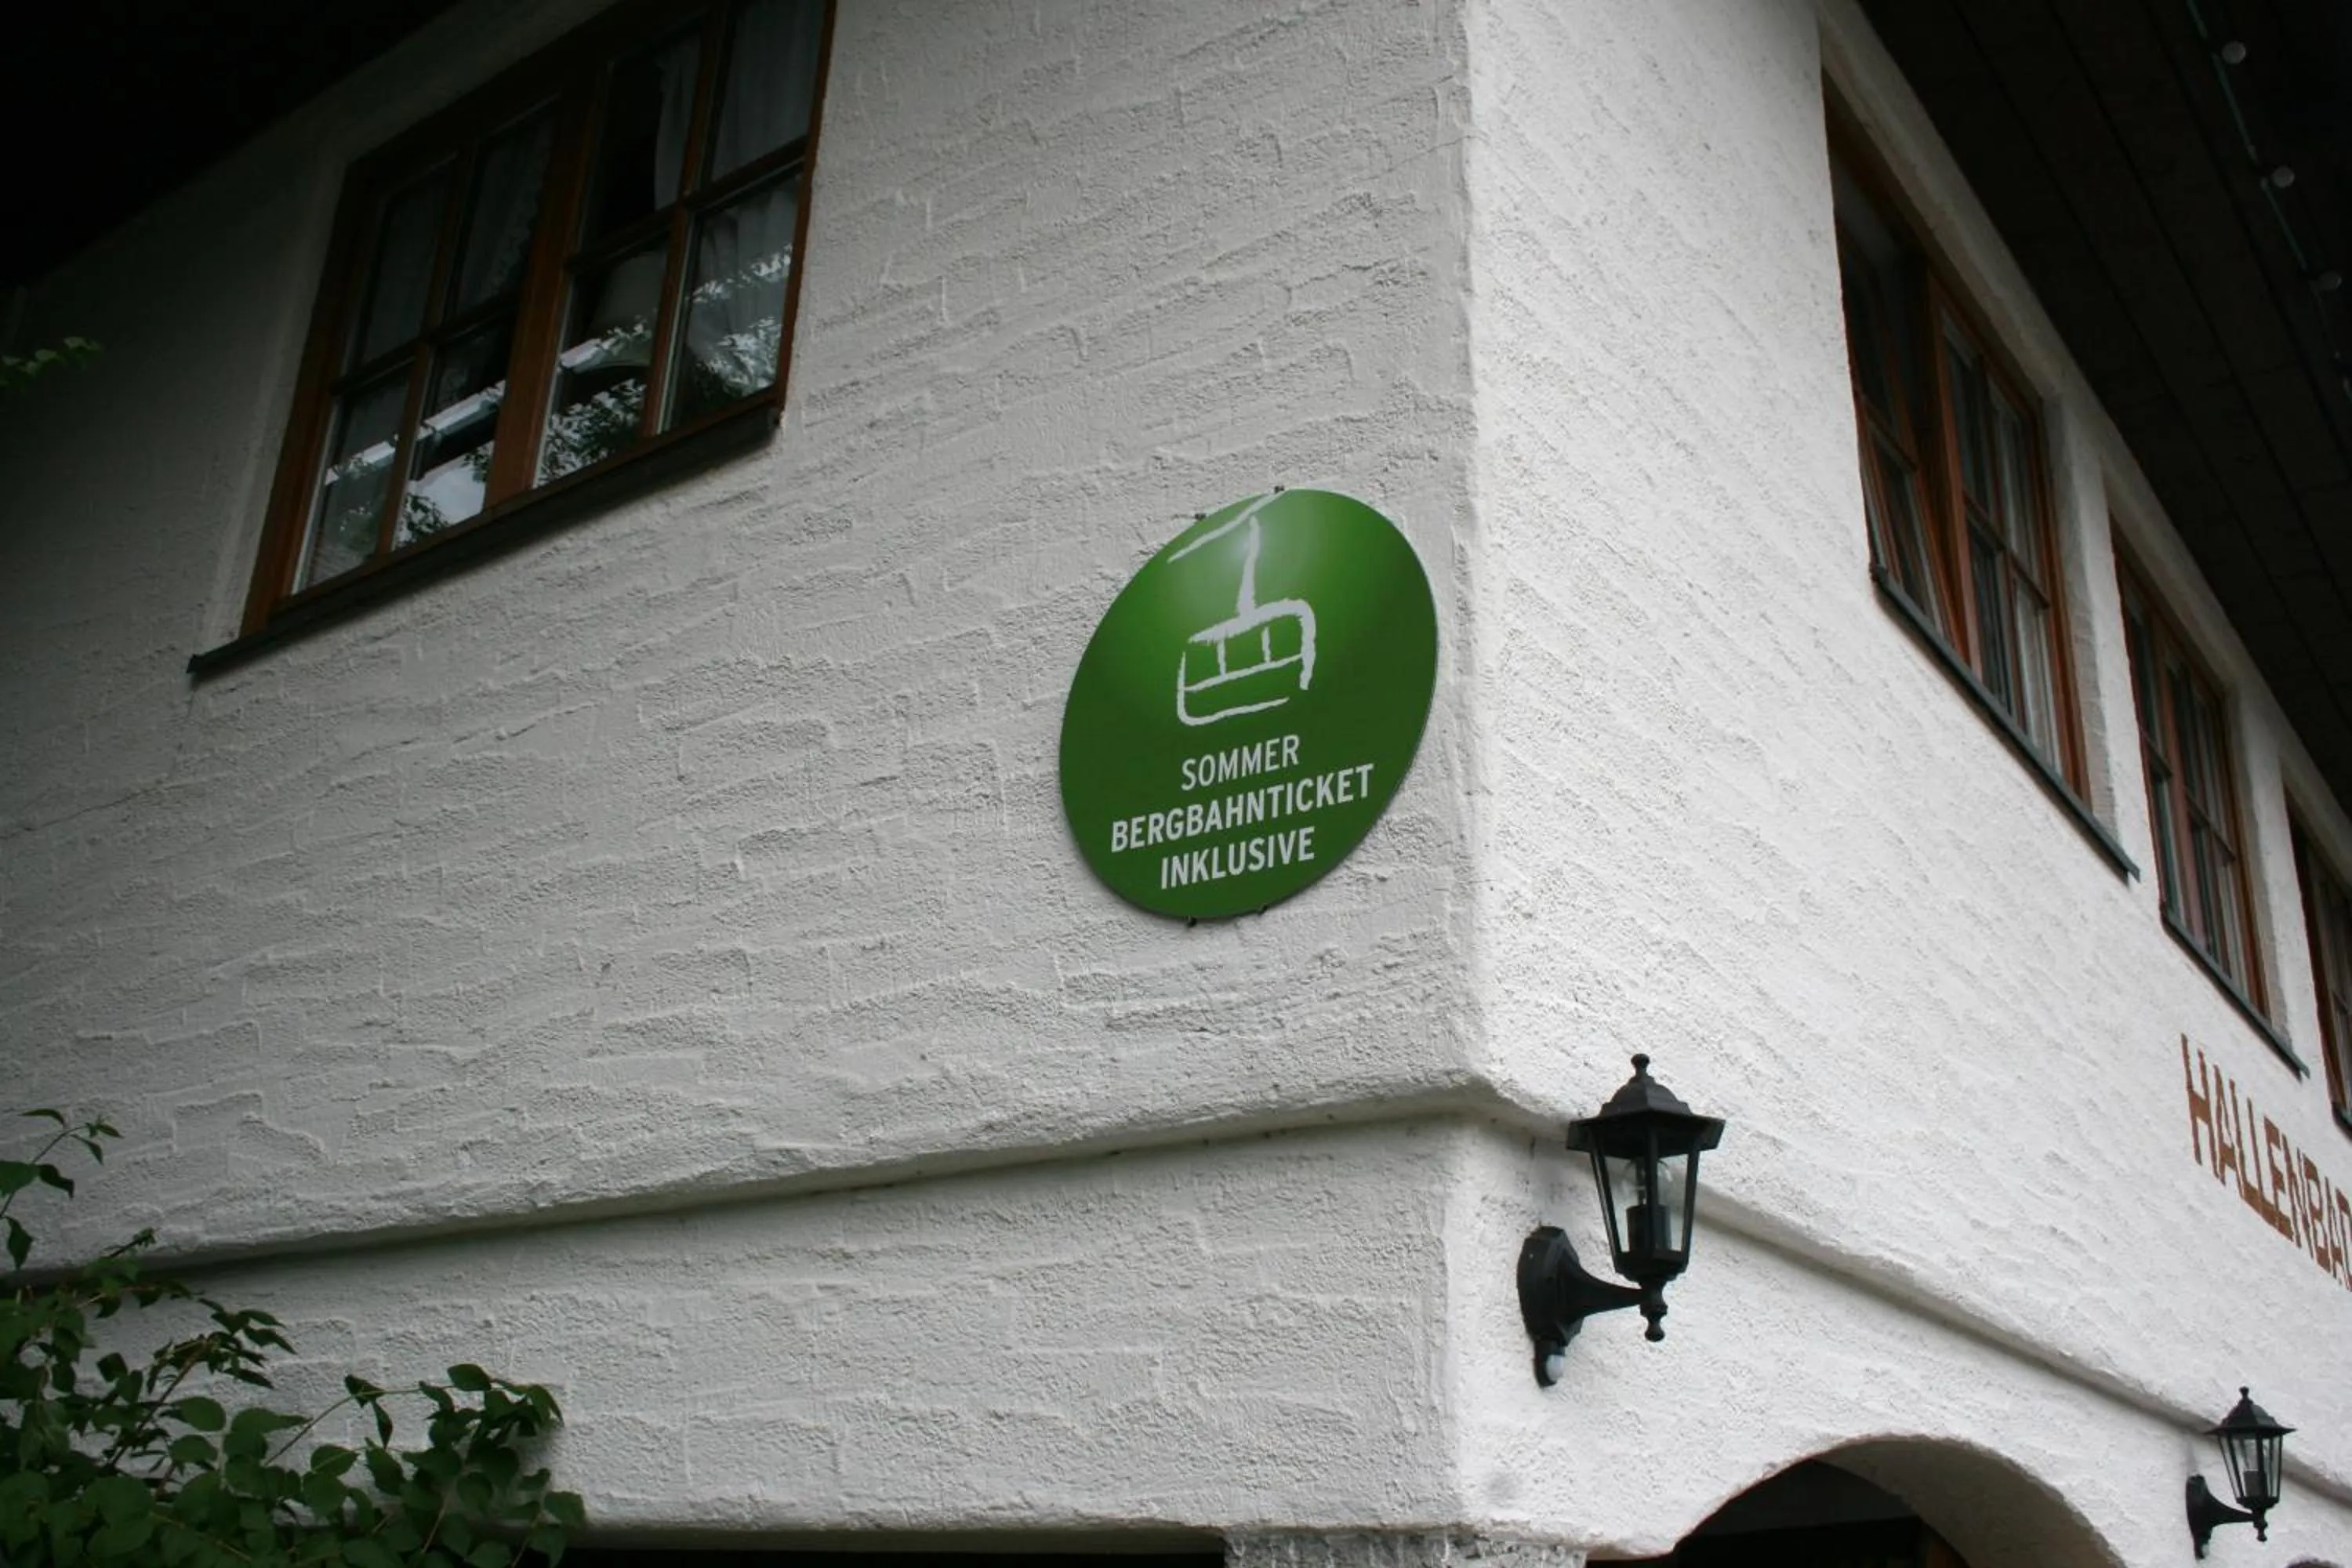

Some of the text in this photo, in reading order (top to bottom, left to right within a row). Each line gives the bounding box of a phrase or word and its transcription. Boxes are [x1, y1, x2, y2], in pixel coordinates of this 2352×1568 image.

[1181, 734, 1300, 791] SOMMER
[1110, 764, 1374, 853] BERGBAHNTICKET
[1160, 826, 1316, 890] INKLUSIVE
